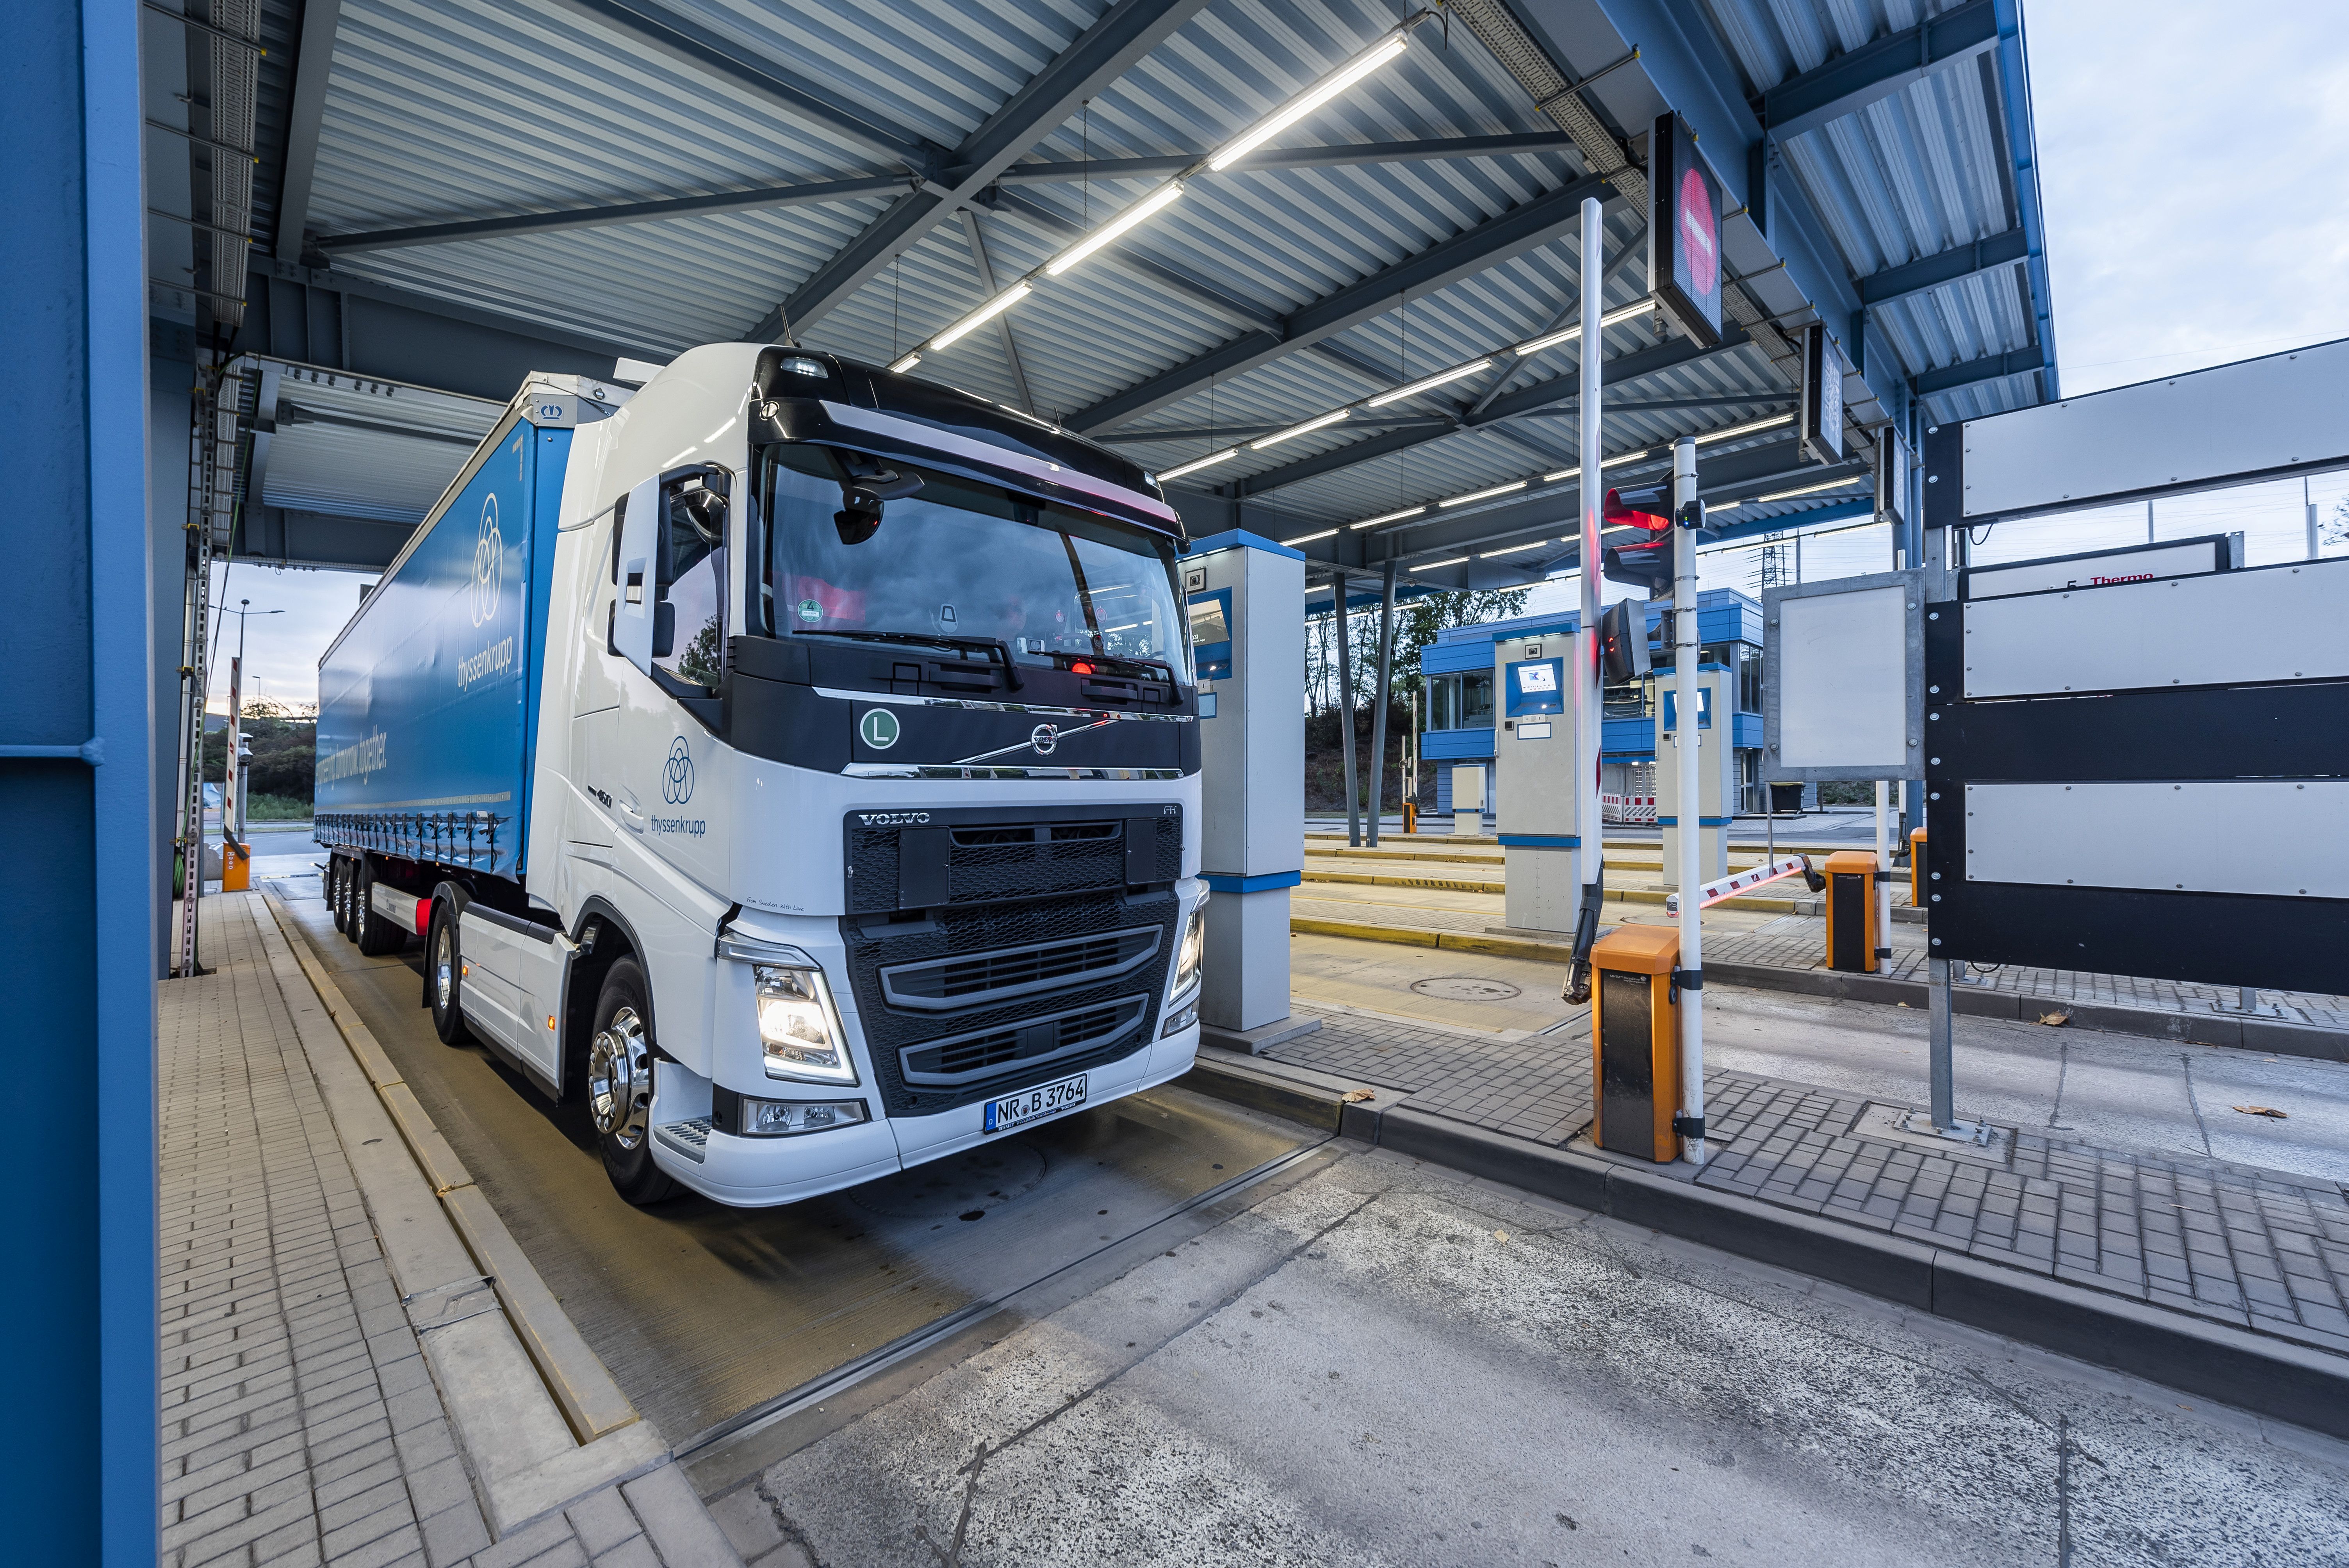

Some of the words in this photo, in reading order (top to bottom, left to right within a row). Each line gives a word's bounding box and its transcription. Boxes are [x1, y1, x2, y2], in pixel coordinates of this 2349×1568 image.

[2090, 573, 2153, 585] Thermo
[807, 601, 814, 609] 4
[458, 636, 512, 692] thyssenkrupp
[873, 717, 889, 741] L
[597, 789, 612, 809] 460
[1164, 806, 1177, 814] FH
[858, 813, 930, 825] VOLVO
[651, 814, 706, 838] thyssenkrupp
[758, 899, 777, 908] Sweden
[998, 1098, 1020, 1124] NR
[1032, 1092, 1042, 1113] B
[1046, 1078, 1084, 1107] 3764
[998, 1123, 1015, 1131] RENAULT
